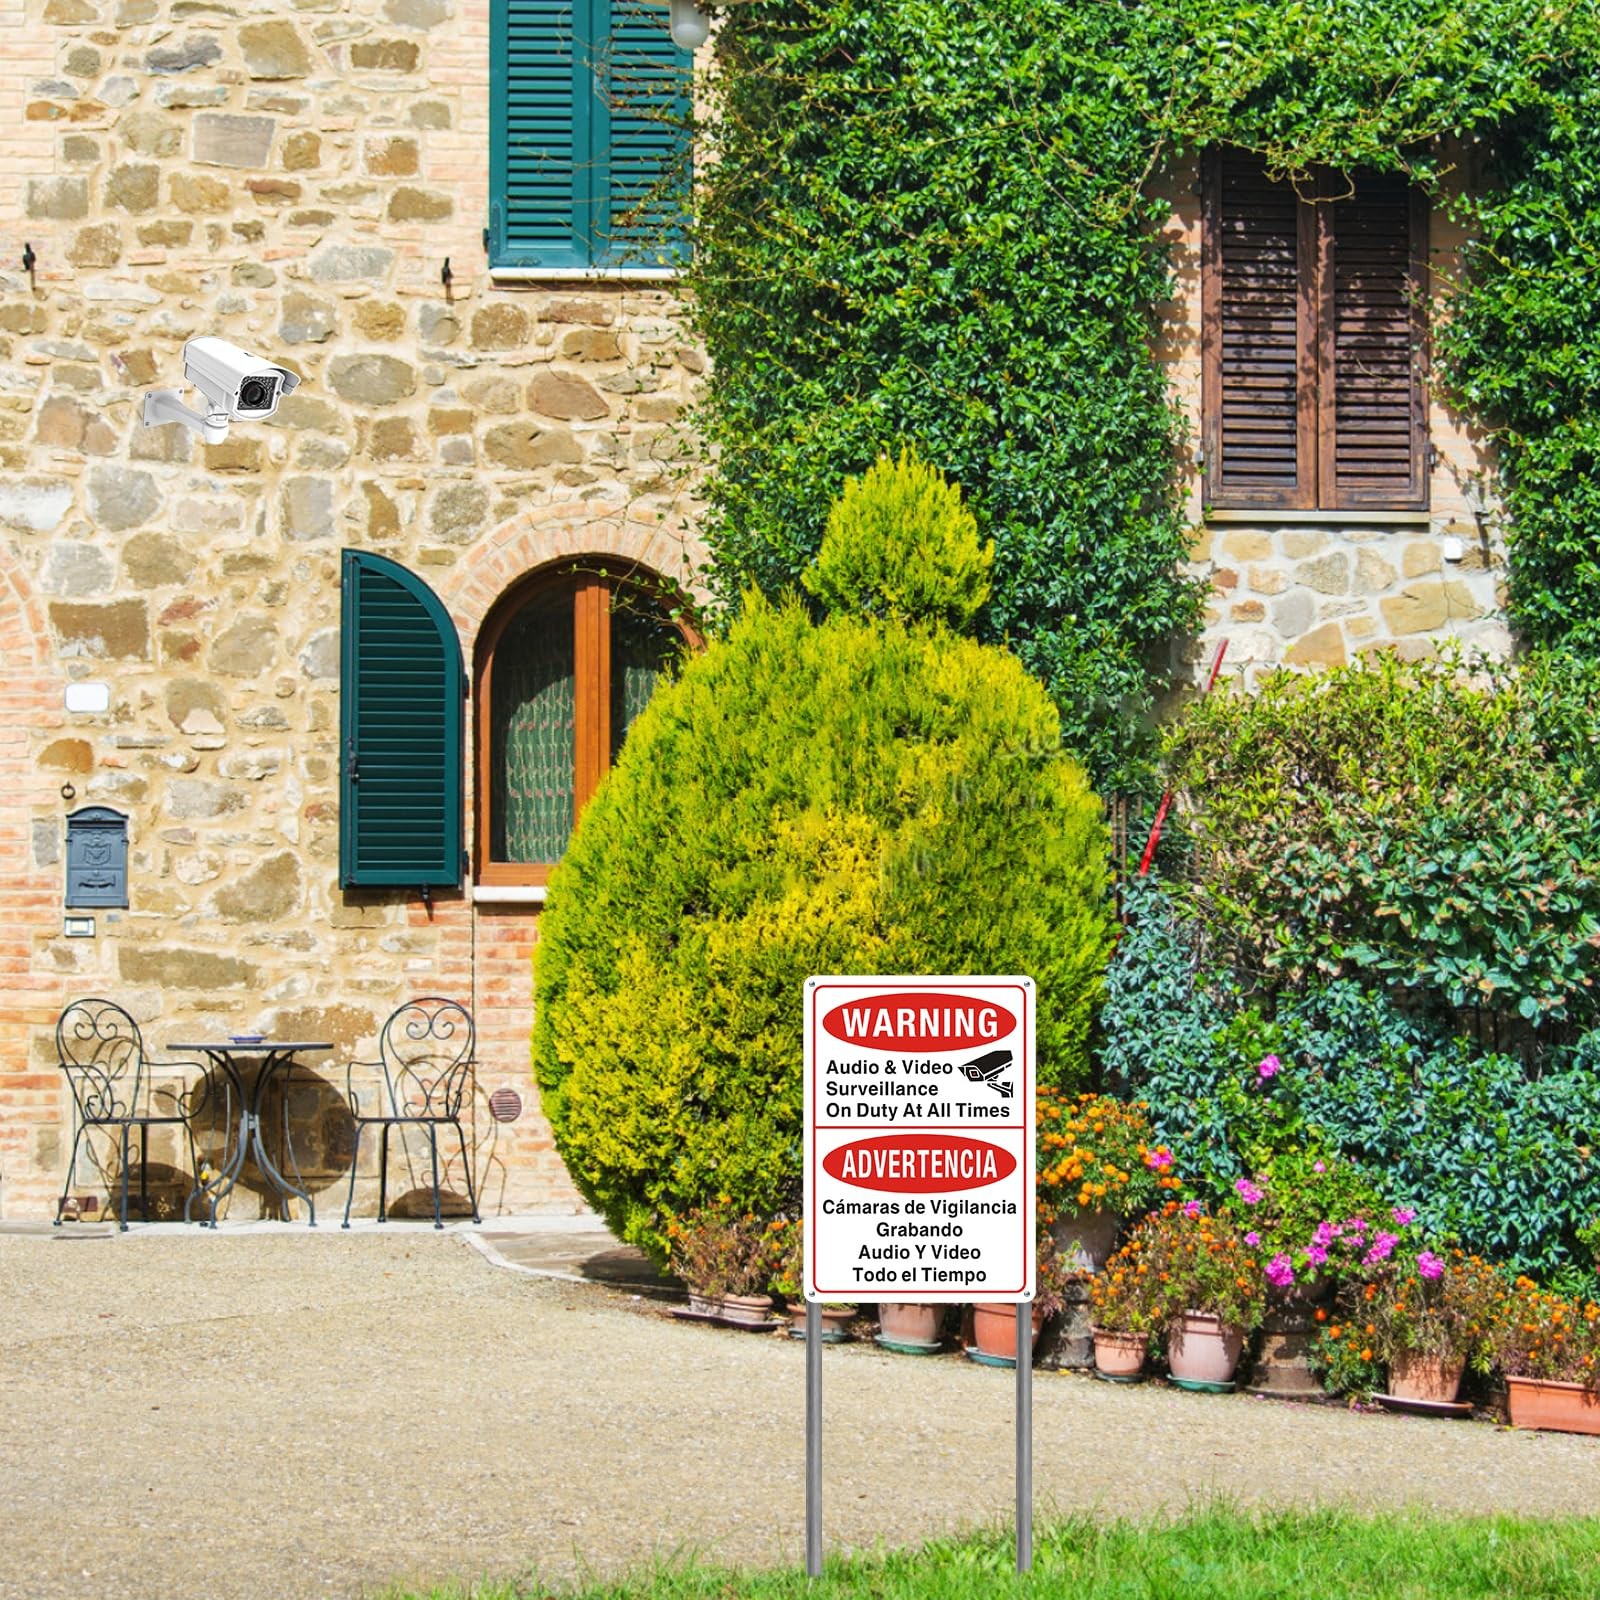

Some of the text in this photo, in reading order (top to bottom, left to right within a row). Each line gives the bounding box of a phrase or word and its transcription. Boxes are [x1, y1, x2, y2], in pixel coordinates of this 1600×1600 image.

[842, 1008, 997, 1037] WARNING
[826, 1059, 953, 1075] Audio & Video
[826, 1080, 939, 1097] Surveillance
[826, 1102, 1010, 1122] On Duty At All Times
[842, 1149, 997, 1178] ADVERTENCIA
[822, 1198, 1017, 1218] Cámaras de Vigilancia
[876, 1221, 963, 1238] Grabando
[858, 1244, 981, 1260] Audio Y Video
[852, 1267, 987, 1286] Todo el Tiempo
